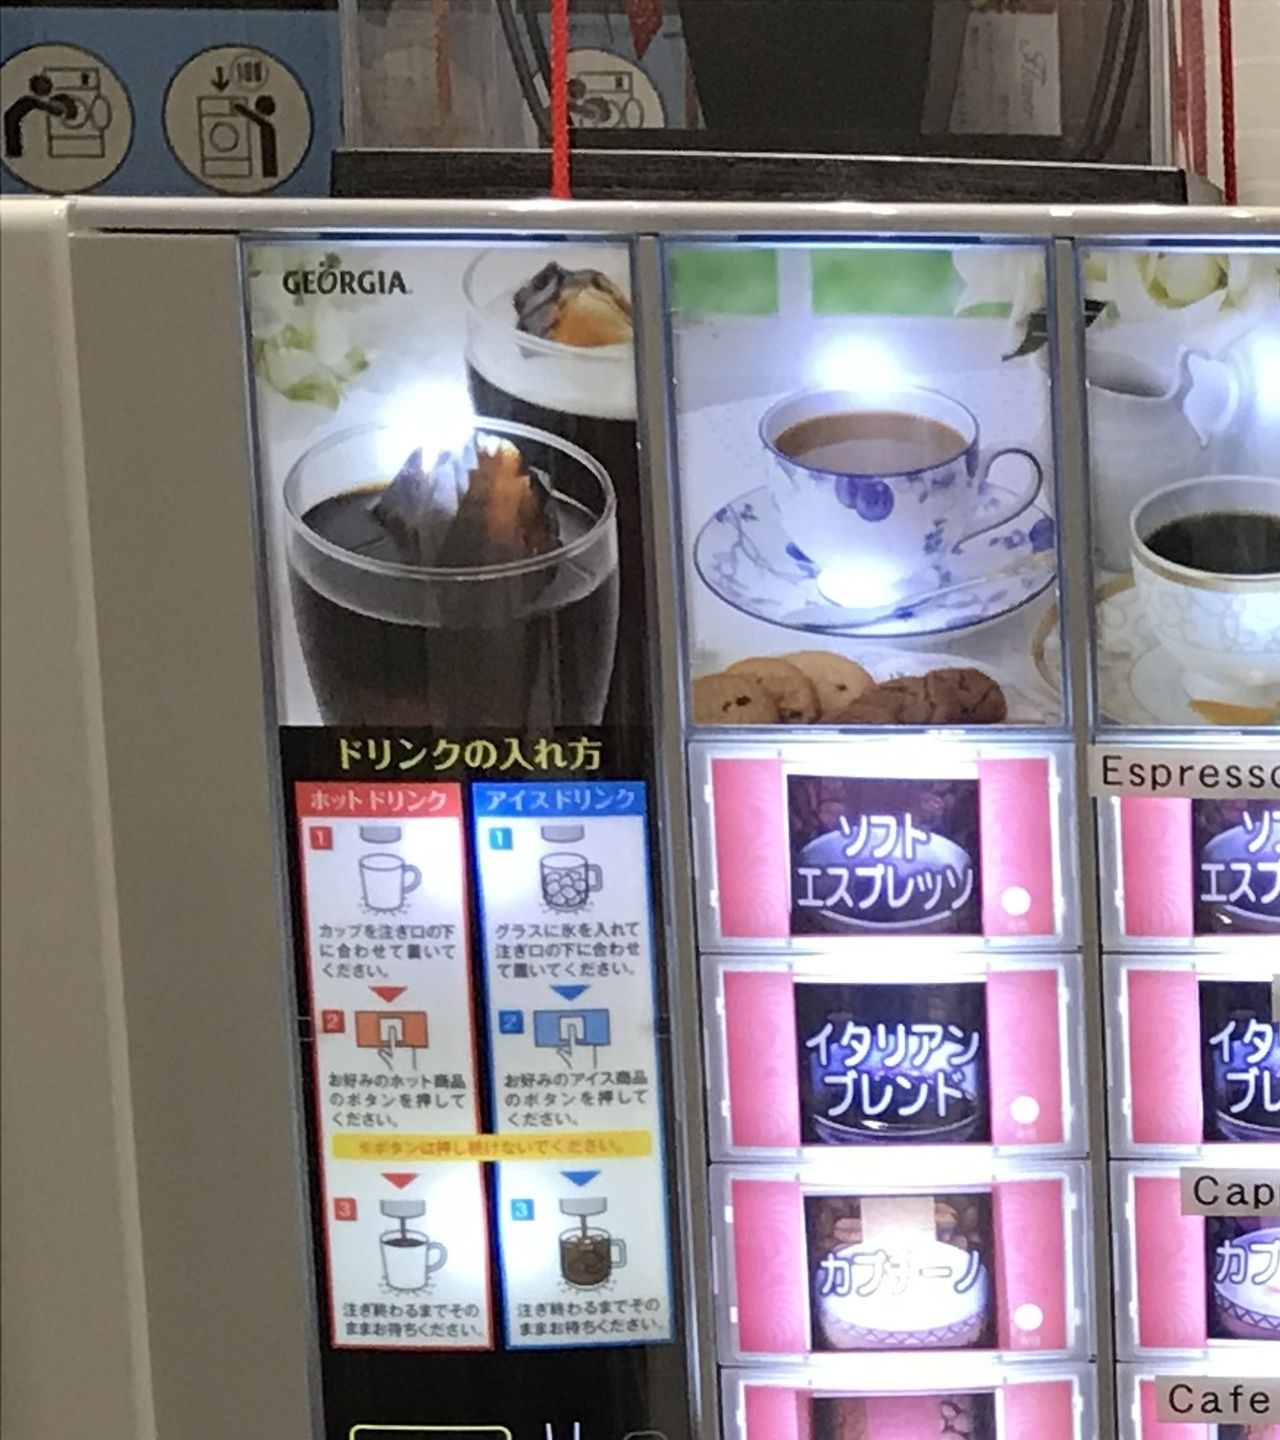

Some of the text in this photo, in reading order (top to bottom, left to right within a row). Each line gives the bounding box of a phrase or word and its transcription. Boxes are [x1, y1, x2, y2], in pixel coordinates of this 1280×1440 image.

[282, 270, 412, 295] GEORGIA
[339, 736, 602, 771] ドリンクの入れ方
[310, 789, 447, 810] ホットドリンク
[486, 788, 635, 811] アイスドリンク
[840, 812, 928, 860] ソフト
[797, 863, 974, 910] エスプレッソ
[319, 923, 456, 940] カップを注ぎ口の下
[495, 921, 640, 939] グラスに氷を入れて
[320, 943, 456, 960] に合わせて置いて
[495, 941, 640, 958] 注ぎ口の下に合わせ
[322, 963, 388, 978] ください。
[497, 961, 637, 978] て置いてください。
[806, 1021, 980, 1068] イタリアン
[328, 1073, 466, 1089] お好みのホット商品
[505, 1072, 648, 1089] お好みのアイス商品
[330, 1092, 467, 1108] のボタンを押して
[505, 1090, 647, 1108] のボタンを押して
[823, 1069, 965, 1117] ブレンド
[332, 1112, 398, 1127] ください。
[507, 1112, 579, 1127] ください。
[819, 1249, 980, 1298] カプチーノ
[343, 1302, 480, 1319] 注ぎ終わるまでその
[517, 1298, 660, 1318] 注ぎ終わるまでその
[345, 1321, 483, 1338] ままお待ちください。
[1168, 1382, 1271, 1415] Cafe
